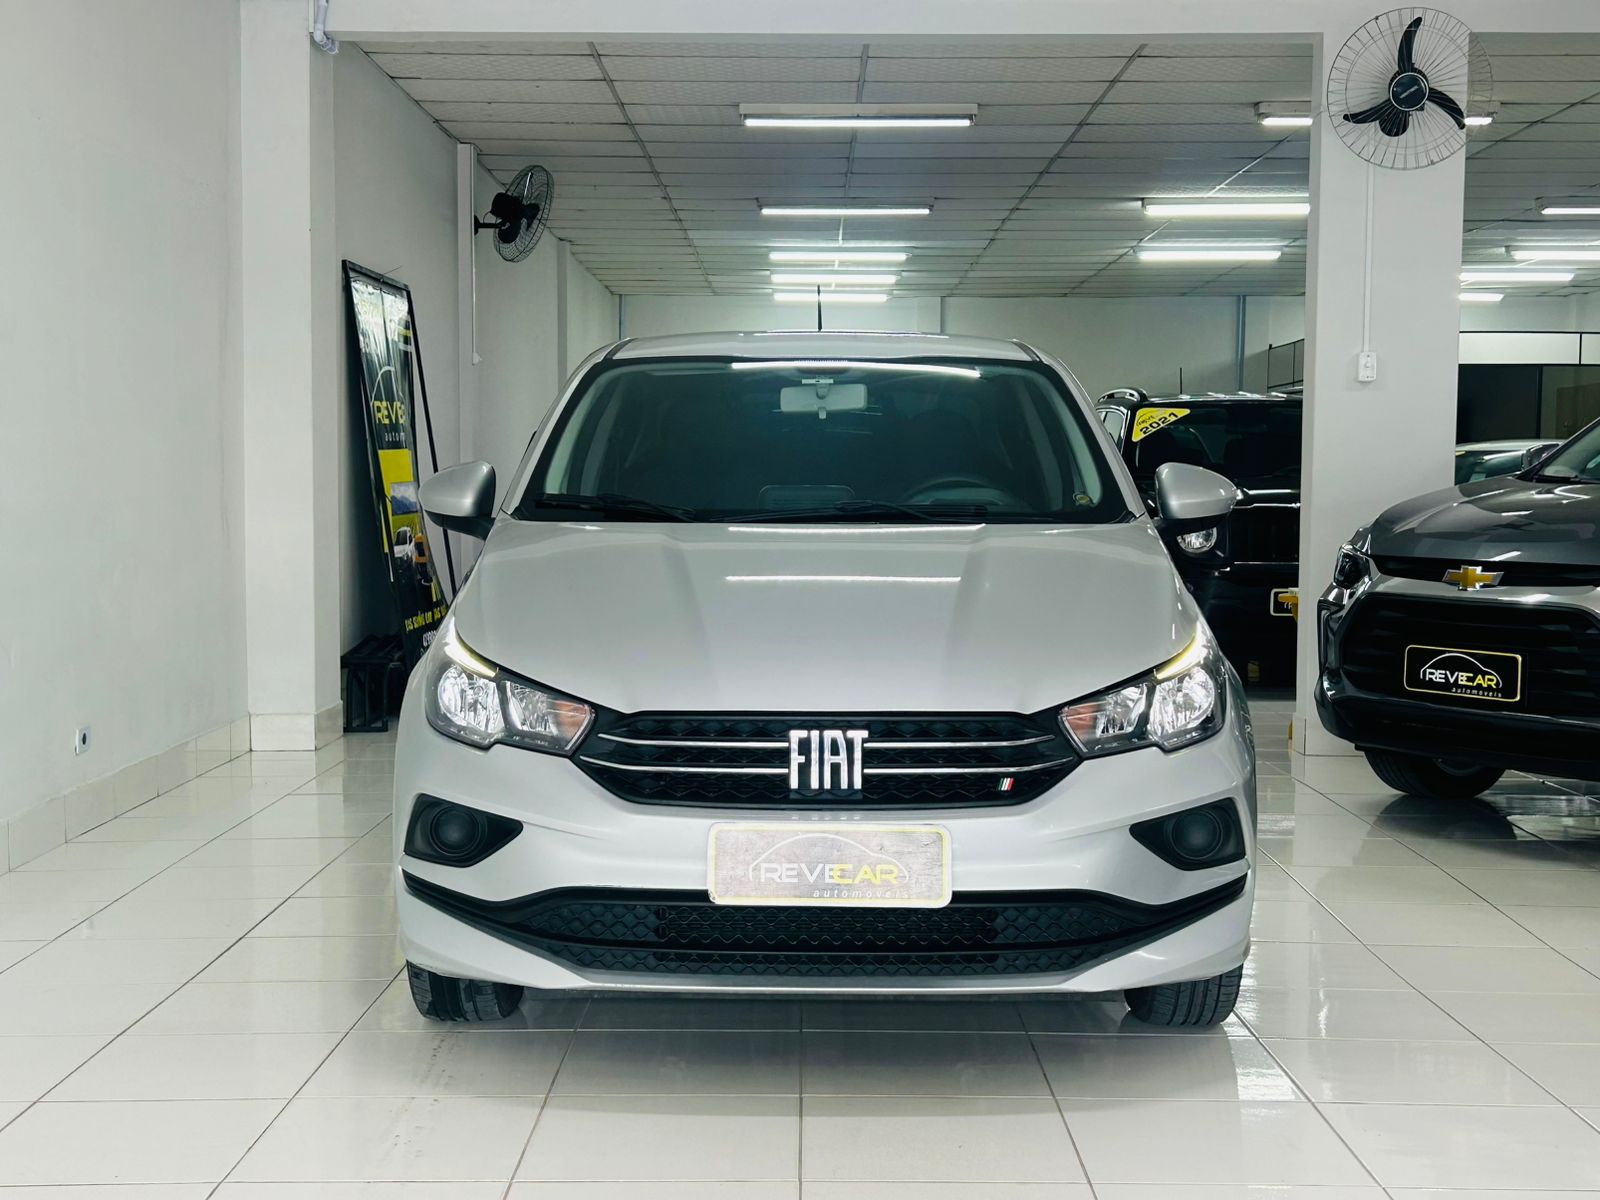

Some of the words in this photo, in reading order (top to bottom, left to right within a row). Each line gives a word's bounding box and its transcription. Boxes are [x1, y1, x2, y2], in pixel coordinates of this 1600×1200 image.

[1139, 412, 1179, 435] 2021
[1425, 668, 1498, 689] REVECAR
[788, 729, 869, 790] FIAT
[759, 862, 899, 885] REVECAR
